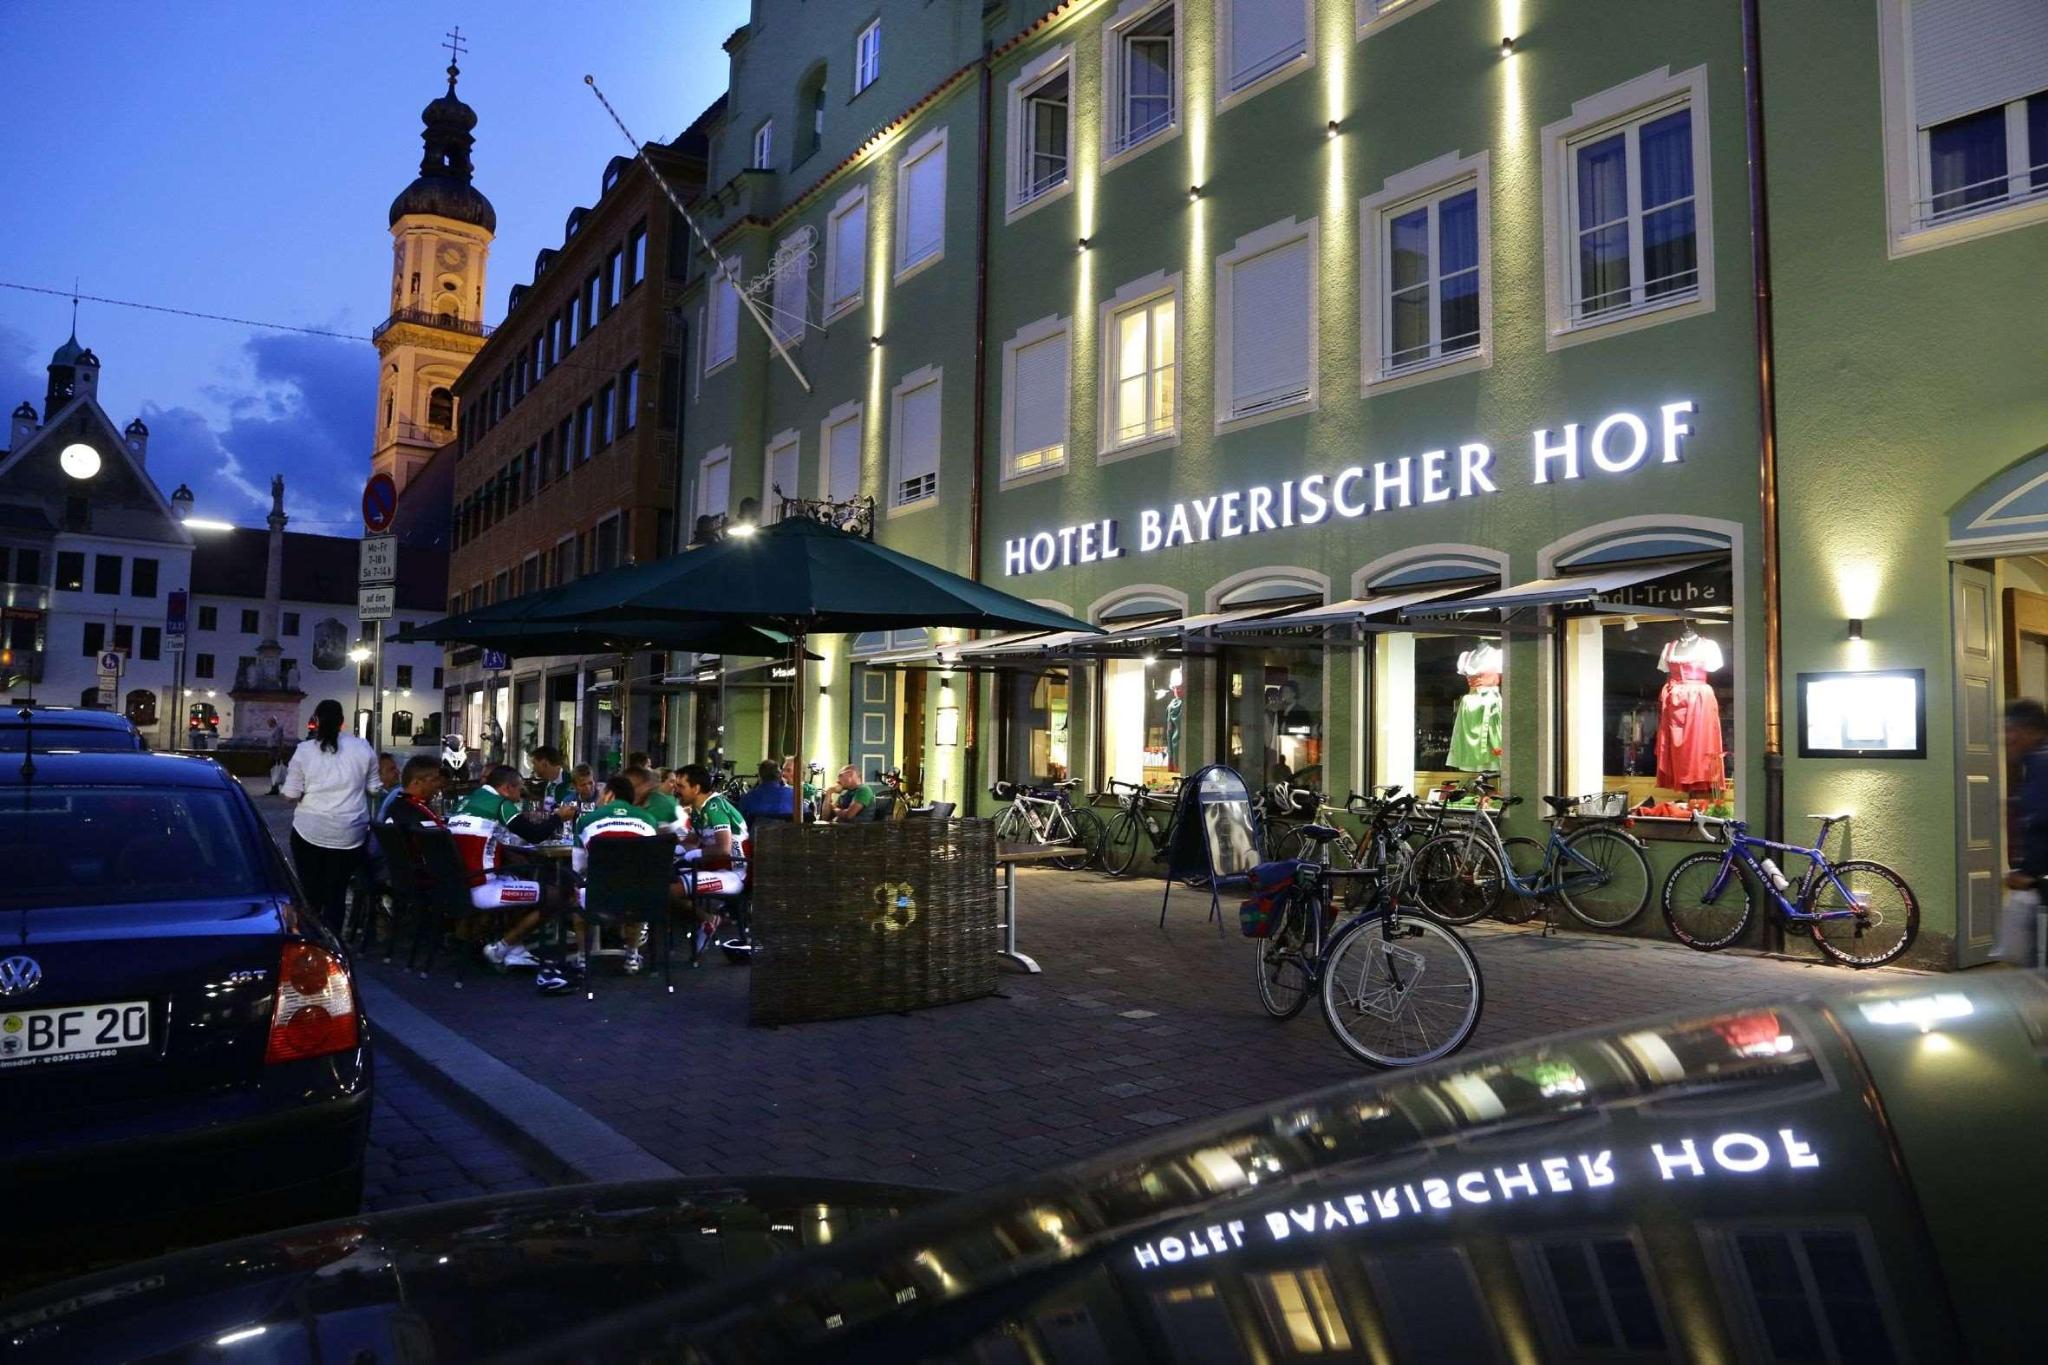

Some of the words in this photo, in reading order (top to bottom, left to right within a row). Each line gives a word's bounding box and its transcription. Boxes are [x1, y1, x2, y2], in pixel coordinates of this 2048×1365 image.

[1006, 520, 1119, 577] HOTEL
[1141, 443, 1497, 552] BAYERISCHER
[1533, 401, 1692, 485] HOF
[367, 542, 388, 552] Mo-Fr
[363, 568, 371, 577] Sa
[168, 621, 185, 631] TAXI
[28, 1011, 84, 1051] BF
[95, 1006, 146, 1044] 20
